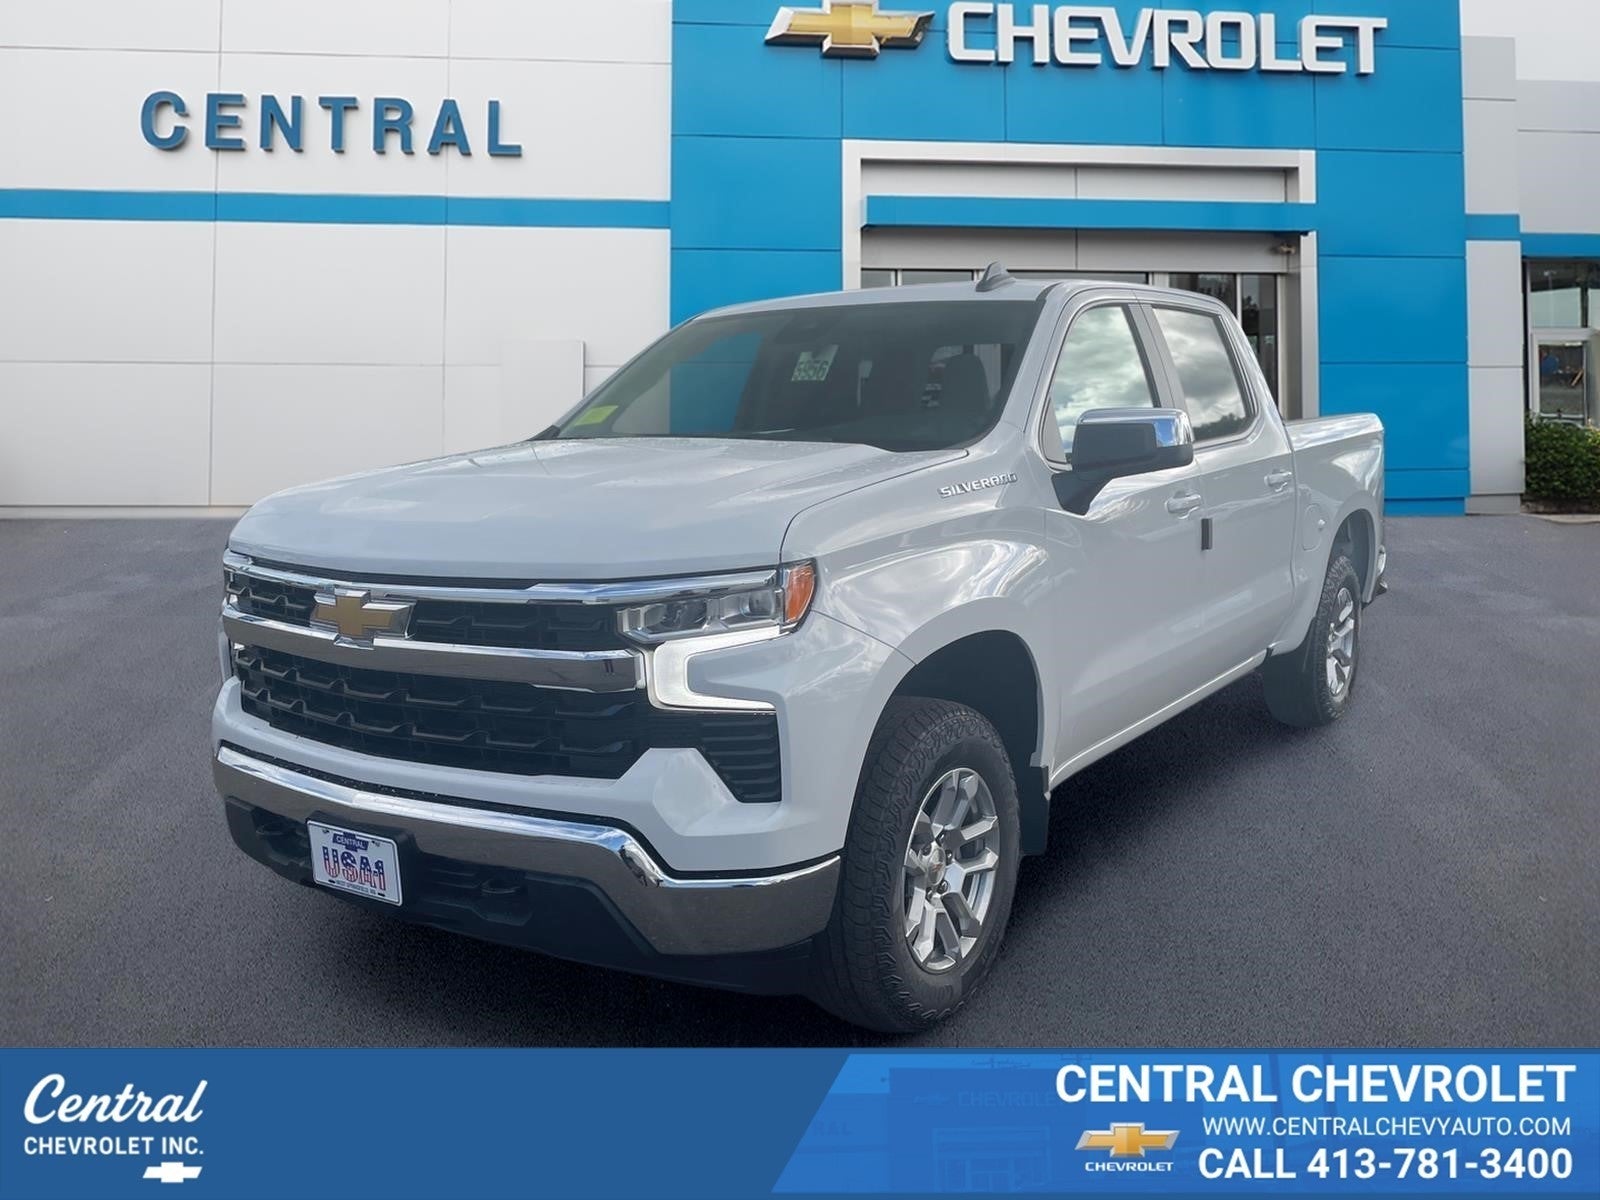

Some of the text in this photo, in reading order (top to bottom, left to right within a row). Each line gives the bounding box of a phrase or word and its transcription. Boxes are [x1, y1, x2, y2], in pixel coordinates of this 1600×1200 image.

[948, 2, 1388, 74] CHEVROLET
[141, 91, 523, 158] CENTRAL
[939, 472, 1018, 498] SILVERADO
[335, 834, 366, 850] CENTRAL
